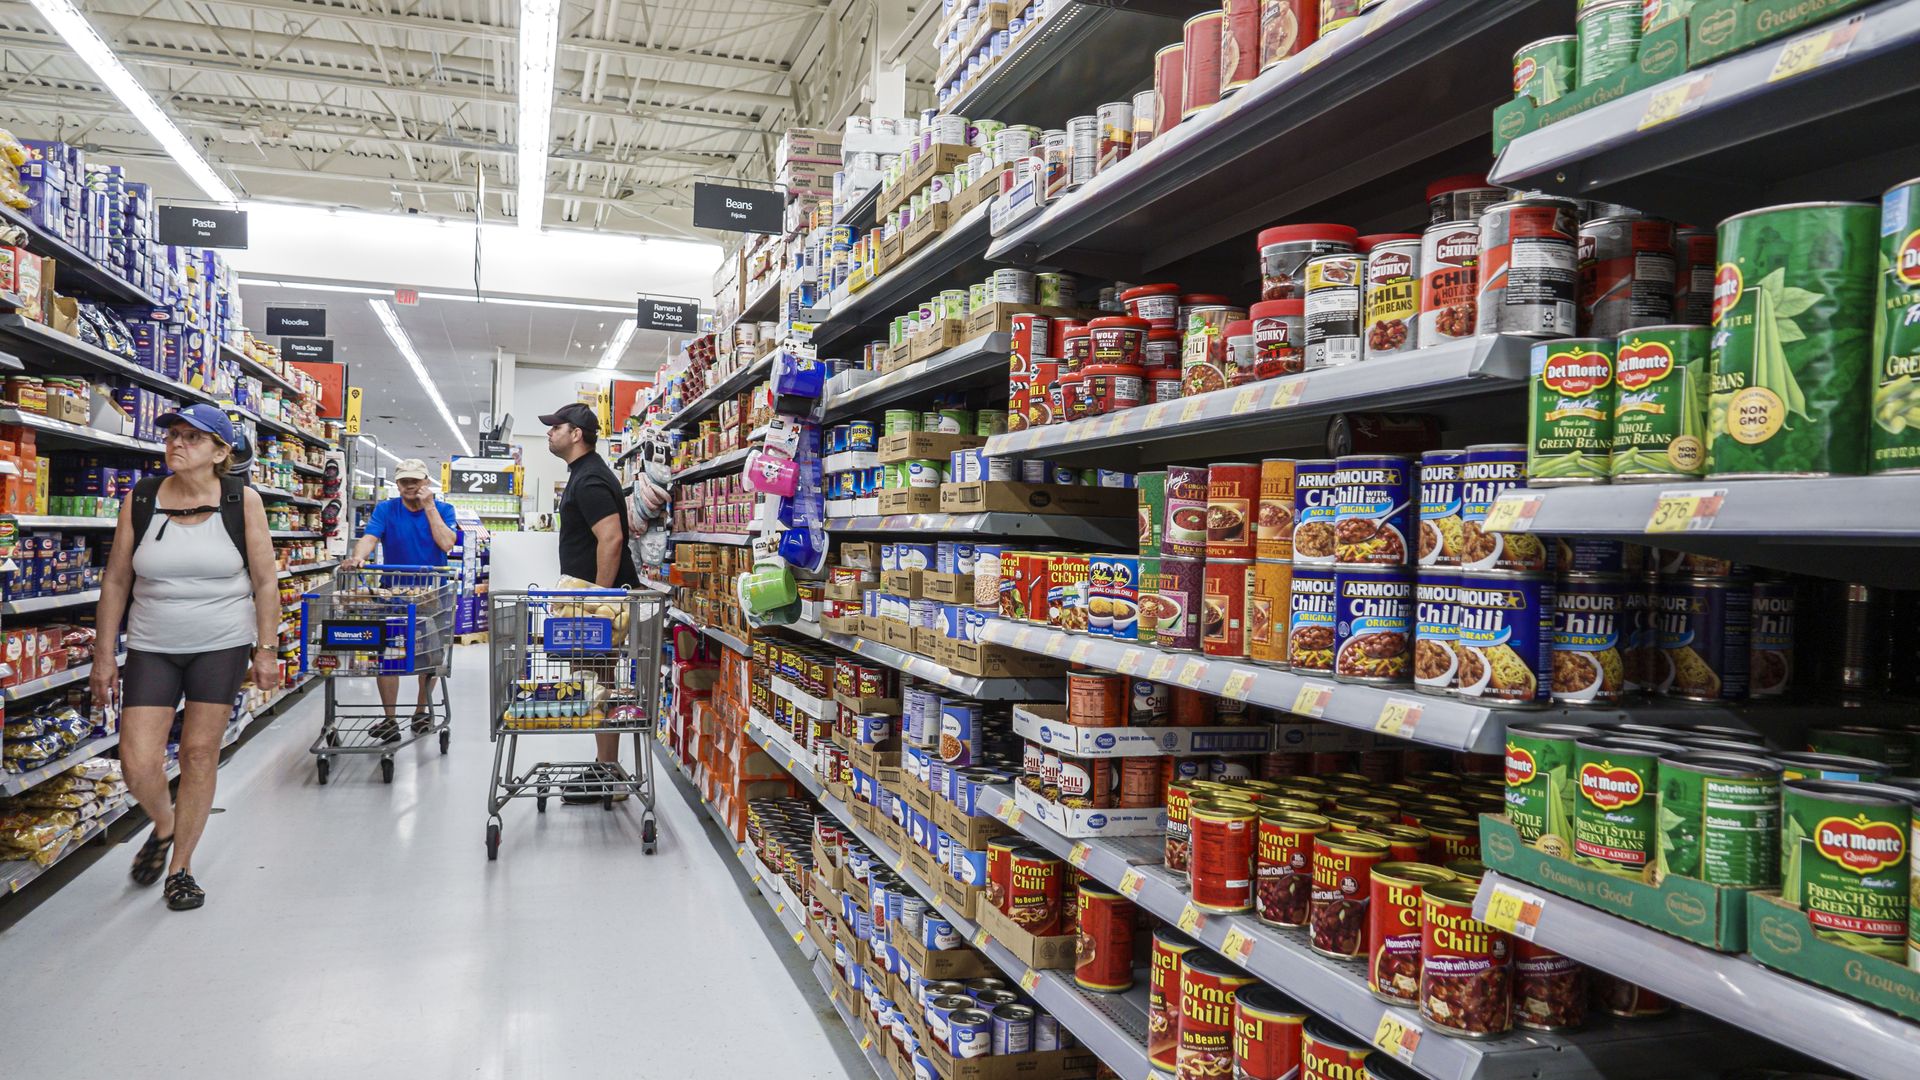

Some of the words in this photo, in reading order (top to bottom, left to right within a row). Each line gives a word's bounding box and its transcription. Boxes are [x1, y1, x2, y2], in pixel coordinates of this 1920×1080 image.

[1592, 76, 1627, 104] Good
[725, 198, 753, 210] Beans
[192, 218, 216, 229] Pasta
[1371, 262, 1410, 278] CHUNKY
[396, 289, 416, 304] EXIT
[1368, 284, 1412, 308] CHILI
[1442, 287, 1458, 298] HOT
[654, 303, 676, 312] Ramen
[676, 304, 682, 312] &
[1386, 300, 1412, 314] BEANS
[281, 318, 310, 326] Noodles
[653, 312, 665, 322] Dry
[666, 313, 682, 322] Soup
[1096, 332, 1118, 340] WOLF
[1255, 328, 1286, 342] CHUNKY
[1629, 356, 1668, 371] Monte
[1886, 354, 1920, 376] GRE
[1548, 365, 1566, 378] Del
[1568, 364, 1608, 378] Monte
[1562, 380, 1589, 388] Quality
[1624, 374, 1647, 382] Quality
[1556, 398, 1579, 410] Fresh
[1579, 400, 1600, 409] Cut
[1740, 406, 1768, 415] NON
[350, 415, 358, 423] A
[1740, 416, 1768, 426] GMO
[852, 427, 871, 435] BUSH'S
[1554, 427, 1596, 438] WHOLE
[1618, 422, 1653, 434] WHOLE
[1539, 438, 1574, 449] GREEN
[1576, 438, 1612, 448] BEANS
[1633, 433, 1672, 444] BEANS
[1167, 472, 1190, 490] Amy's
[1263, 478, 1292, 496] HILI
[1212, 482, 1241, 498] HILI
[1336, 486, 1365, 504] Chili
[1422, 483, 1455, 503] hili
[1366, 496, 1392, 504] BEANS
[1174, 544, 1195, 552] BLACK
[1208, 546, 1228, 556] SPICY
[1000, 557, 1020, 566] ormel
[1064, 572, 1088, 583] Chili
[1292, 580, 1336, 593] ARMOU
[1346, 583, 1410, 598] ARMOUR
[1292, 594, 1328, 612] Chili
[1350, 598, 1397, 618] Chili
[1300, 614, 1336, 622] ORIGINA
[1366, 618, 1406, 628] ORIGINAL
[1418, 626, 1432, 634] NO
[1554, 614, 1614, 636] Chili
[1467, 630, 1496, 641] BEANS
[1554, 636, 1570, 644] NO
[1571, 635, 1608, 645] BEANS
[1059, 774, 1083, 786] CHILI
[1583, 774, 1599, 788] Del
[1600, 776, 1638, 794] Monte
[1520, 788, 1544, 798] WITH
[1708, 782, 1760, 794] Nutrition
[1595, 790, 1618, 802] Quality
[1168, 808, 1187, 821] Chil
[1513, 812, 1542, 827] STYLE
[1167, 820, 1188, 833] ANGUS
[1707, 816, 1741, 828] Calories
[1577, 818, 1609, 836] FRENCH
[1612, 823, 1646, 840] STYLE
[1259, 830, 1300, 848] ormel
[1577, 830, 1604, 844] GREEN
[1606, 834, 1644, 850] BEANS
[1822, 830, 1848, 849] Del
[1850, 832, 1901, 852] Monte
[1578, 842, 1588, 851] NO
[1589, 844, 1606, 856] SALT
[1608, 850, 1639, 861] ADDED
[1844, 851, 1878, 864] Quality
[1315, 866, 1338, 886] hili
[1860, 876, 1879, 888] Fresh
[1879, 878, 1896, 888] Cut
[1013, 876, 1045, 890] Chili
[1023, 895, 1044, 904] Beans
[1388, 886, 1422, 906] Hor
[1596, 880, 1633, 907] Good
[1808, 882, 1864, 904] FRENCH
[1867, 892, 1908, 908] STYLE
[1809, 896, 1858, 916] GREEN
[1861, 902, 1906, 920] BEANS
[1815, 914, 1830, 924] NO
[1834, 918, 1862, 930] SALT
[1864, 921, 1901, 932] ADDED
[1386, 938, 1421, 950] Homestyle
[1434, 930, 1488, 954] Chili
[1454, 960, 1468, 970] with
[1468, 959, 1490, 970] Beans
[1182, 995, 1230, 1026] Chili
[1184, 1032, 1193, 1044] No
[1194, 1034, 1226, 1045] Beans
